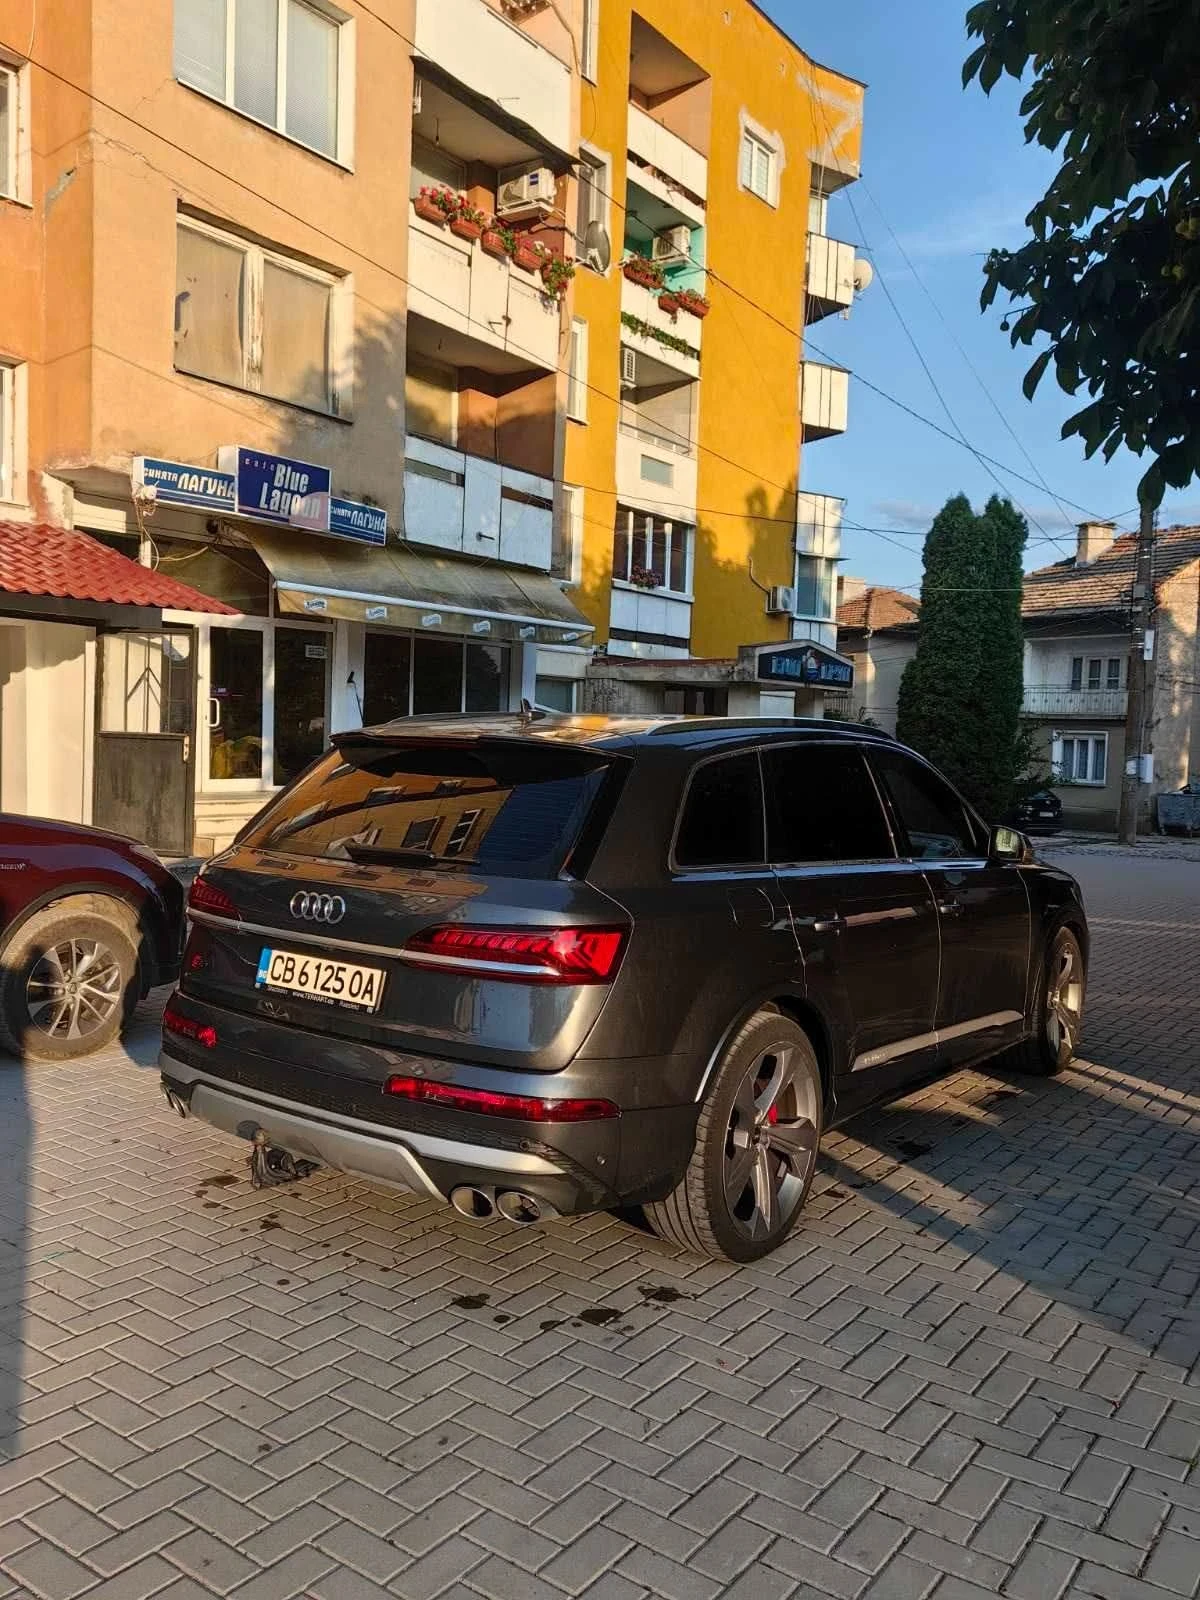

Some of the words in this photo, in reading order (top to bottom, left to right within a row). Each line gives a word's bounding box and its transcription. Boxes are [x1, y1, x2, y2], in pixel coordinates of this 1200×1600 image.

[177, 472, 235, 498] ЛАГУНА
[273, 463, 309, 493] Blue
[259, 481, 321, 519] Lagoon
[350, 510, 385, 533] ЛАГУНА
[271, 955, 296, 984] CB
[298, 960, 346, 994] 6125
